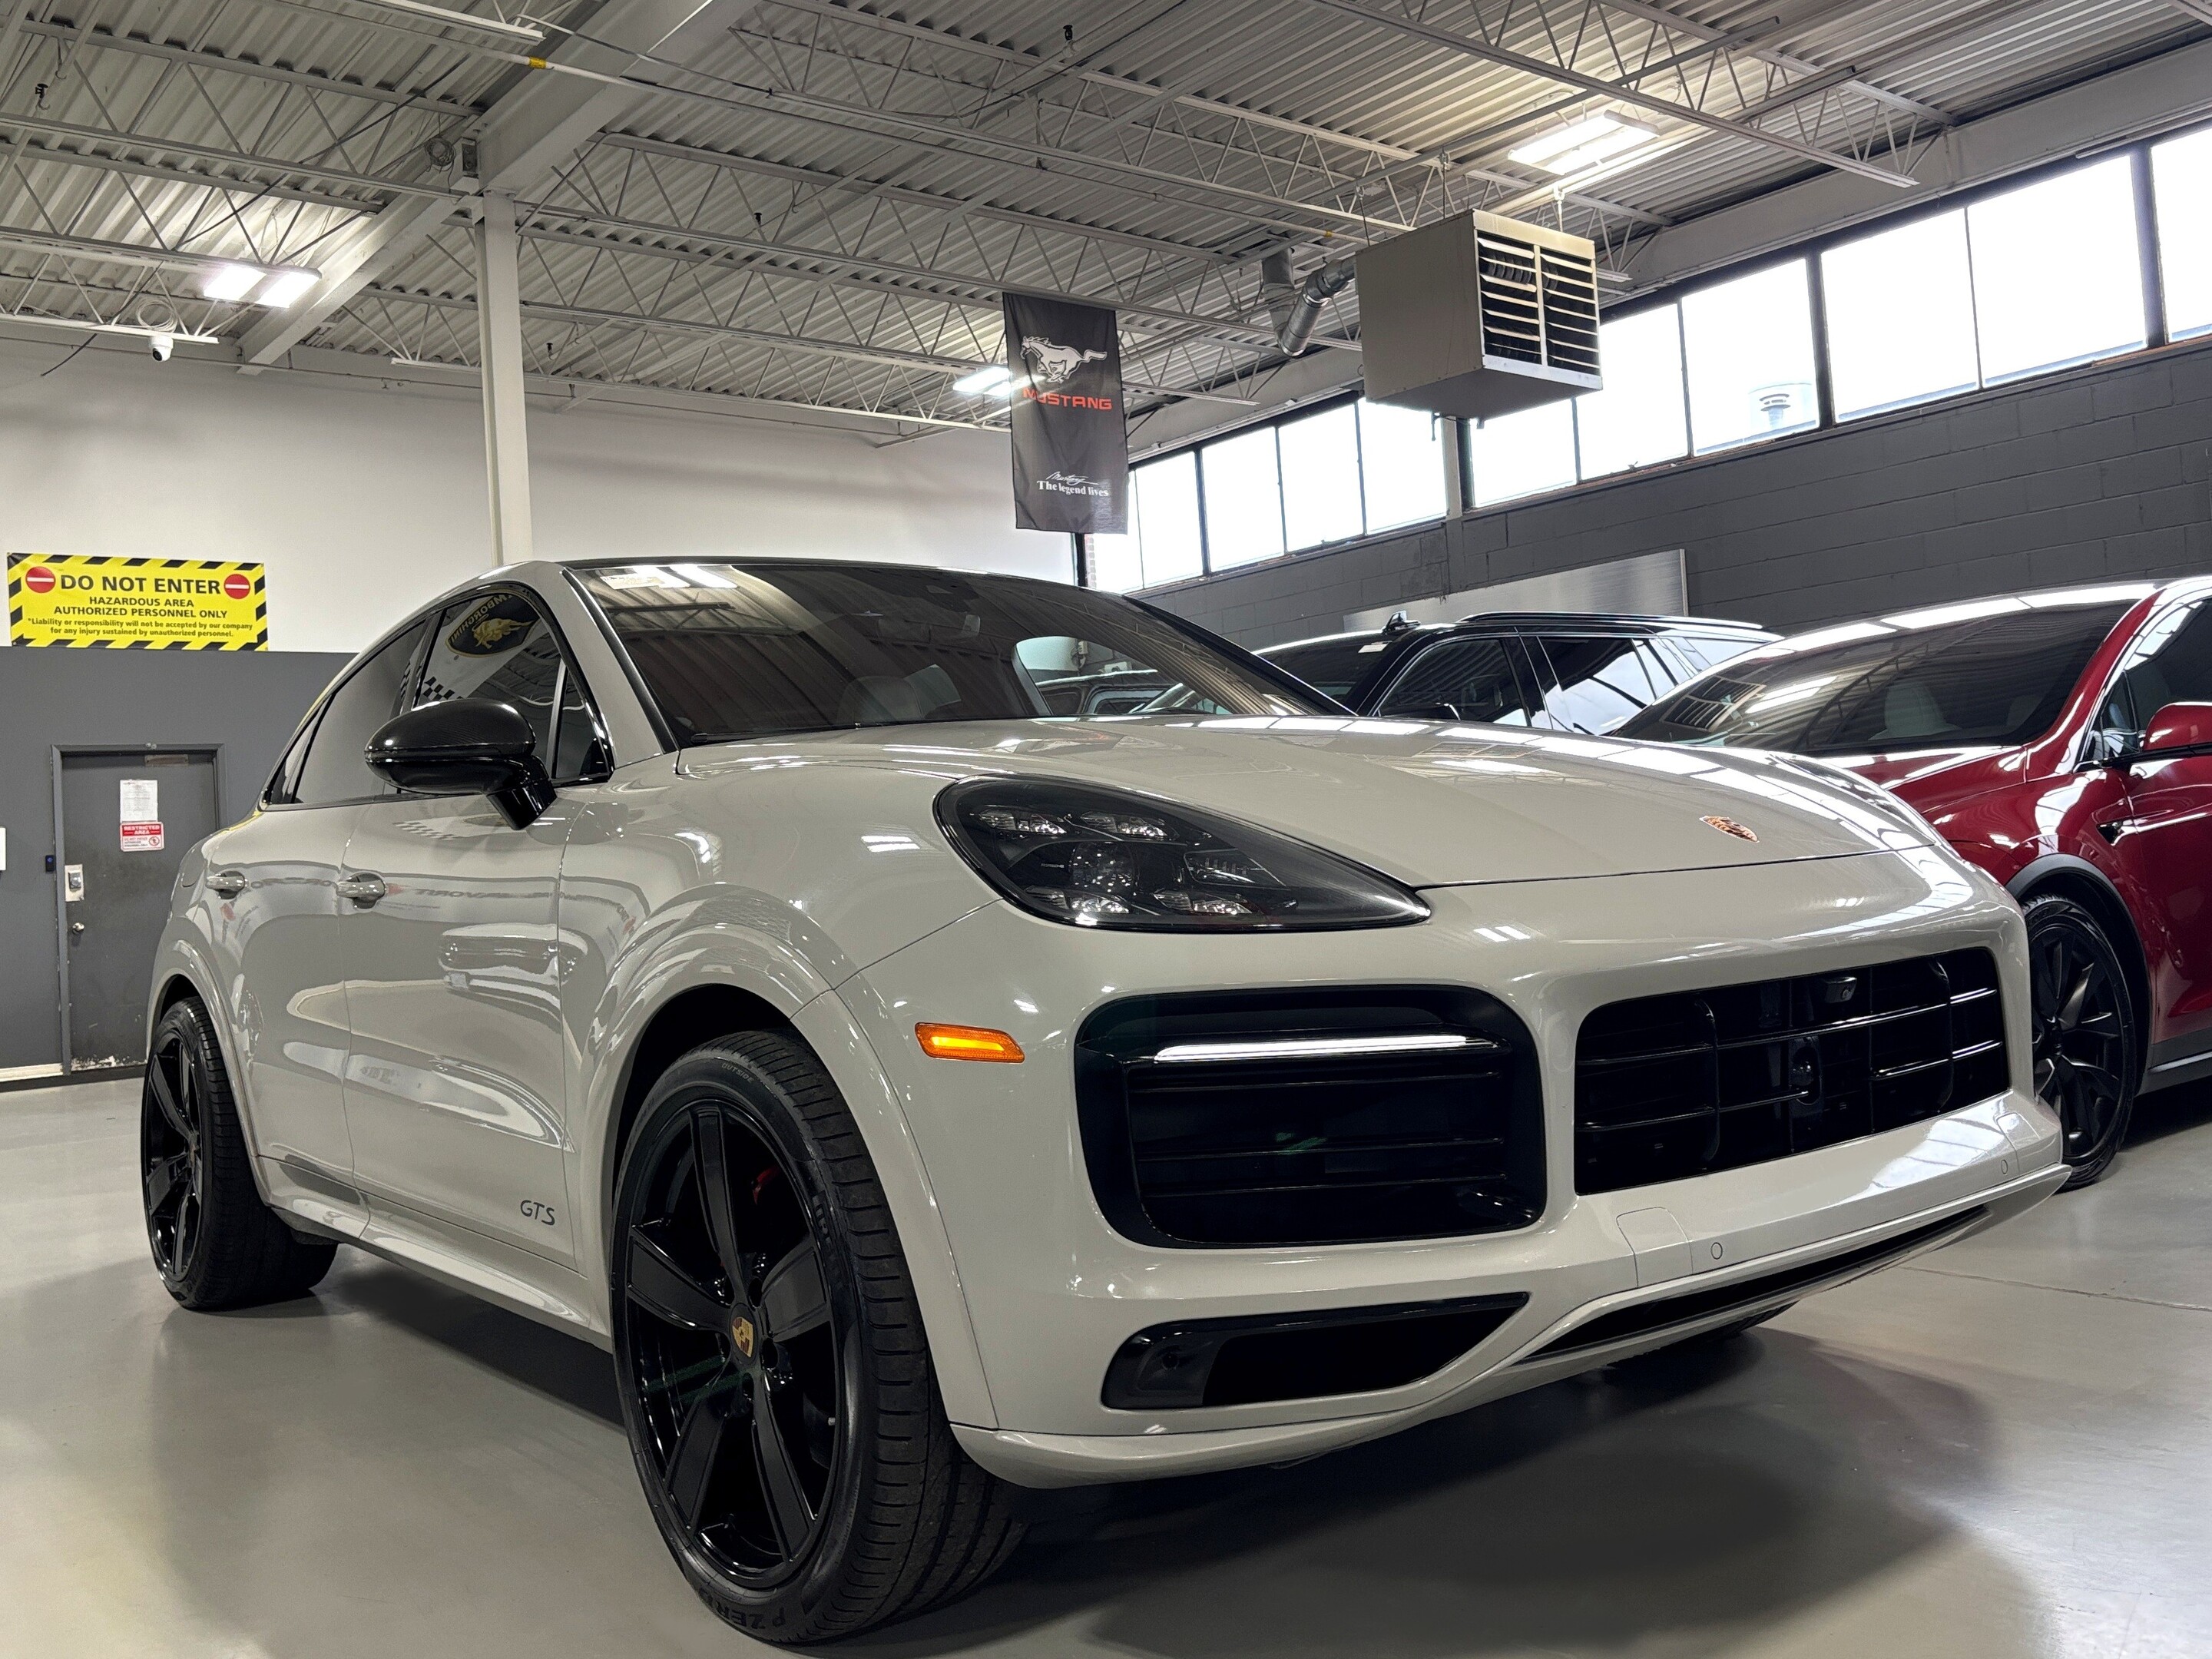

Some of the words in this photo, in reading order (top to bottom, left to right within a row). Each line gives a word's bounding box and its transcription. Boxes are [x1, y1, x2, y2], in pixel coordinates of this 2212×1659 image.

[1022, 387, 1112, 410] MUSTANG
[1037, 480, 1058, 491] The
[1058, 482, 1086, 495] legend
[1088, 486, 1109, 497] lives
[61, 575, 94, 590] DO
[102, 576, 147, 592] NOT
[154, 578, 220, 594] ENTER
[89, 596, 161, 607] HAZARDOUS
[164, 598, 194, 608] AREA
[54, 606, 127, 616] AUTHORIZED
[131, 608, 197, 618] PERSONNEL
[199, 610, 227, 618] ONLY
[75, 619, 124, 628] responsibility
[199, 621, 207, 630] by
[79, 628, 101, 636] injury
[139, 628, 147, 637] by
[722, 1062, 755, 1084] OUTSIDE
[520, 1200, 555, 1226] GTS
